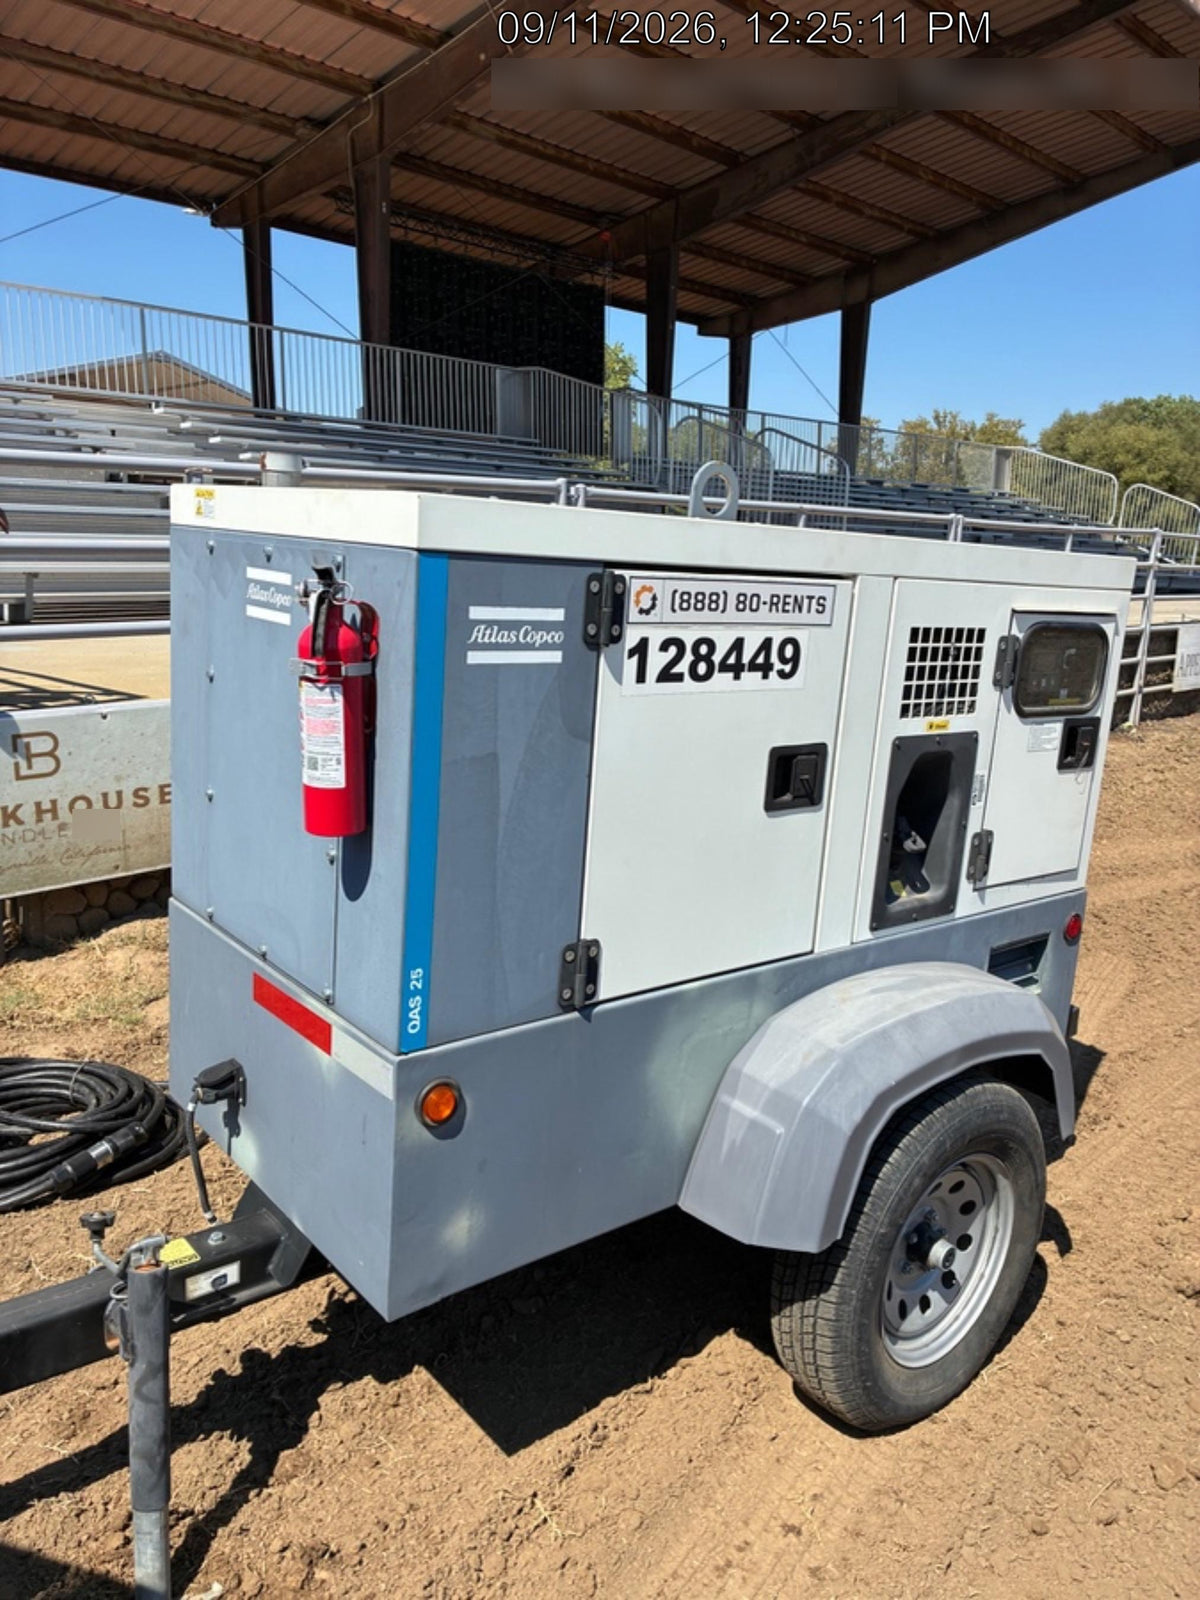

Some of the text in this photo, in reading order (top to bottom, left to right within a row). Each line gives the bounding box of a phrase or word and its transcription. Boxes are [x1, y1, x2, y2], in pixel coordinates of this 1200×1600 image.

[670, 588, 827, 615] (888) 80-RENTS
[467, 624, 565, 648] Atlas Copco
[627, 635, 801, 685] 128449
[406, 967, 424, 1034] QAS 25
